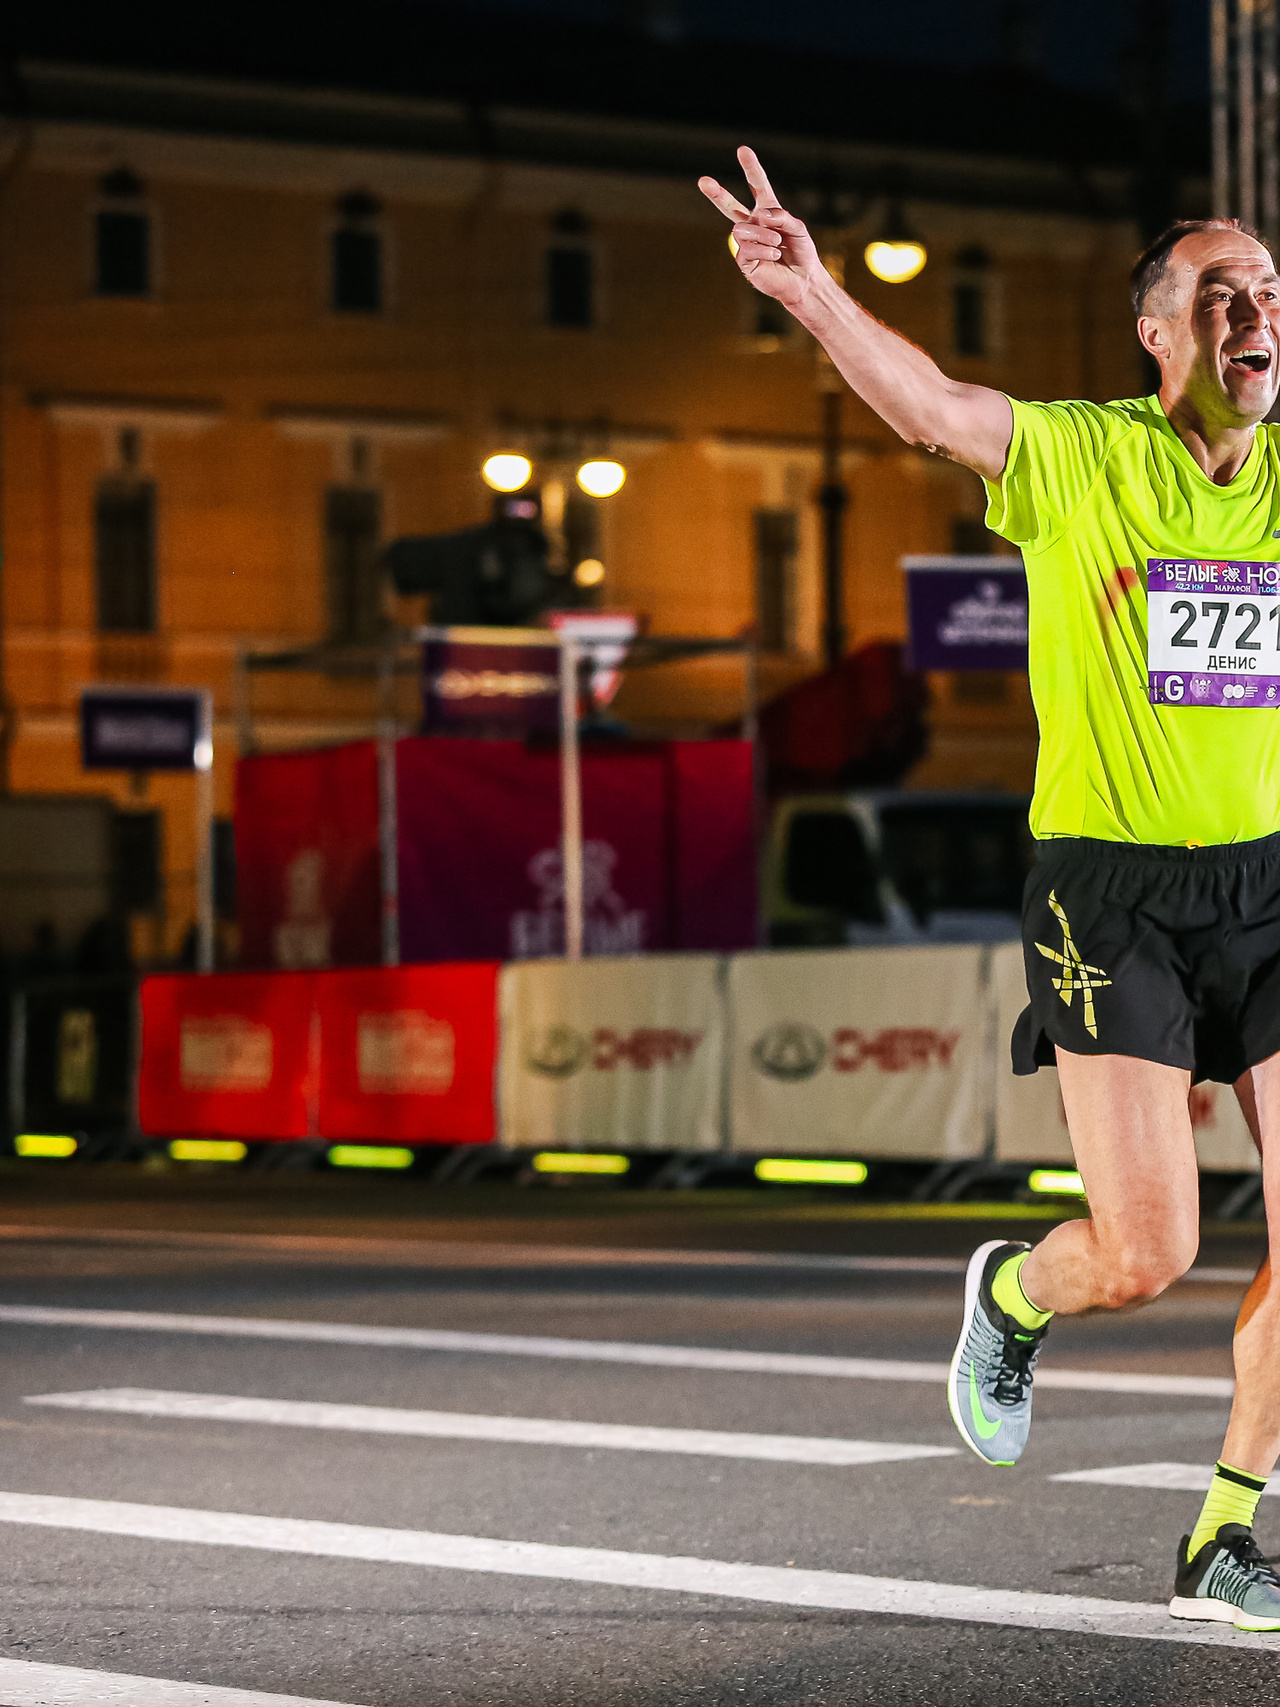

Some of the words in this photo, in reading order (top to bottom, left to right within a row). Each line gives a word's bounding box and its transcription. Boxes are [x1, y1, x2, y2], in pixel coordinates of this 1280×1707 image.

[1164, 563, 1219, 583] БЕЛЫЕ
[1214, 584, 1252, 593] МАРАФОН
[1207, 655, 1257, 671] ДЕНИС
[1164, 674, 1185, 701] G
